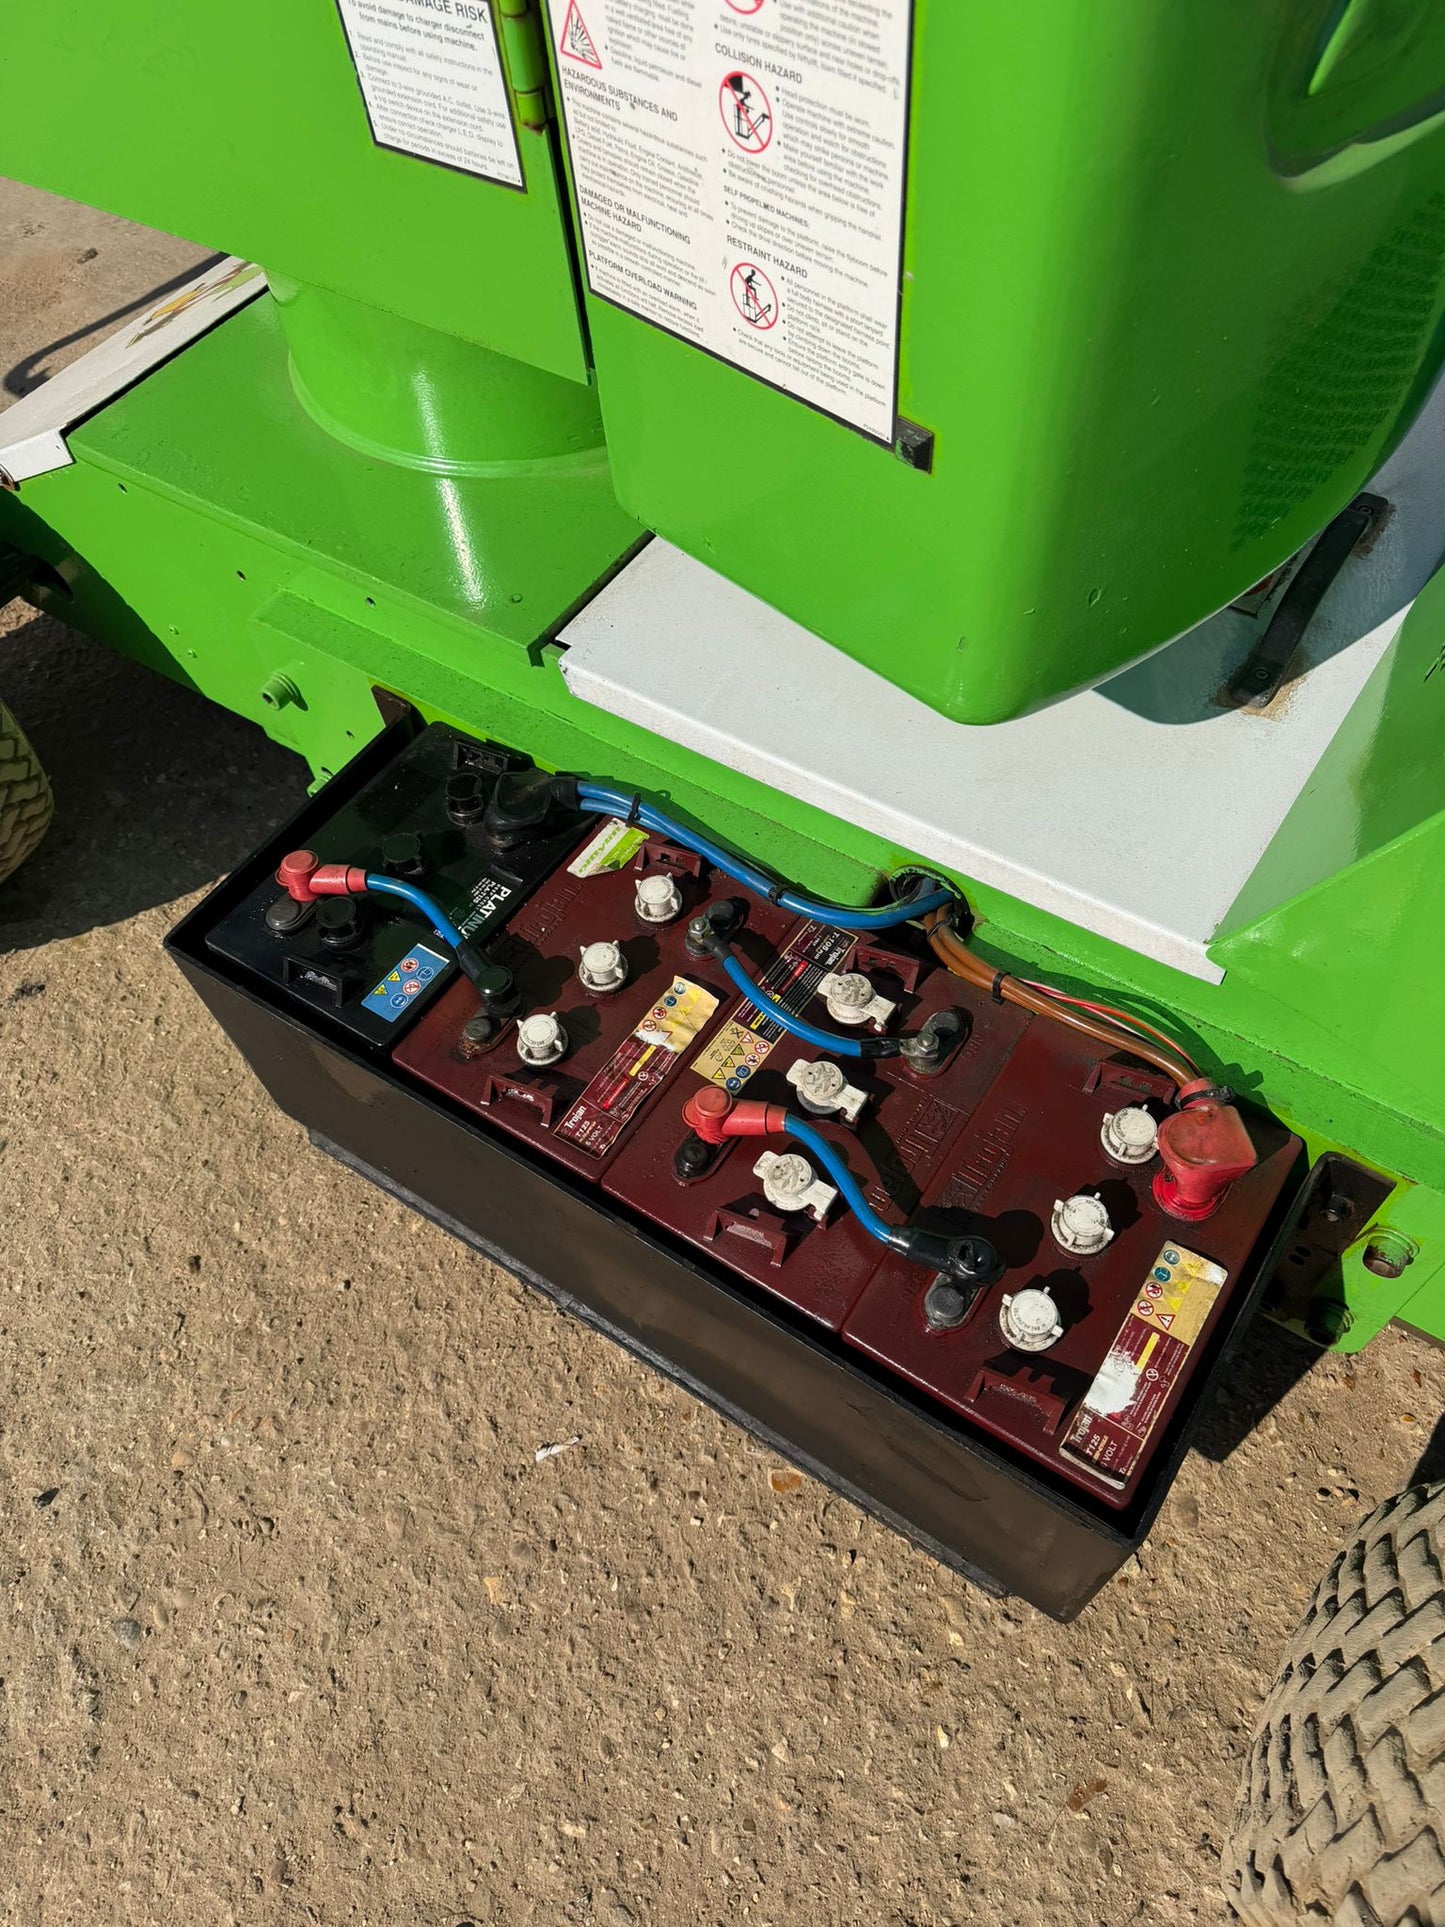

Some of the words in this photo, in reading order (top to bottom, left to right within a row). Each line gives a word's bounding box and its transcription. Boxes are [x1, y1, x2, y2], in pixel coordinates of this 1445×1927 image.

[356, 0, 377, 12] avoid
[376, 4, 406, 22] damage
[405, 11, 414, 22] to
[413, 13, 443, 32] charger
[442, 21, 485, 41] disconnect
[357, 10, 376, 23] from
[375, 15, 398, 30] mains
[397, 21, 422, 36] before
[421, 27, 444, 44] using
[455, 2, 488, 24] RISK
[714, 41, 762, 70] COLLISION
[764, 59, 802, 85] HAZARD
[561, 64, 607, 93] HAZARDOUS
[607, 84, 659, 115] SUBSTANCES
[660, 105, 678, 122] AND
[563, 78, 620, 111] ENVIRONMENTS
[578, 184, 613, 208] DAMAGED
[613, 200, 625, 214] OR
[625, 206, 690, 245] MALFUNCTIONING
[580, 196, 611, 219] MACHINE
[612, 211, 642, 233] HAZARD
[726, 234, 771, 263] RESTRAINT
[772, 255, 807, 279] HAZARD
[588, 249, 623, 274] PLATFORM
[624, 267, 662, 293] OVERLOAD
[663, 286, 697, 310] WARNING
[458, 883, 512, 940] PLATINU
[821, 931, 839, 951] T-105
[824, 944, 845, 966] Trojan
[563, 1103, 588, 1131] Trojan
[574, 1119, 591, 1138] T125
[587, 1124, 603, 1142] VOLT
[1069, 1412, 1095, 1445] Trojan
[1085, 1433, 1101, 1455] T125
[1102, 1439, 1119, 1462] VOLT
